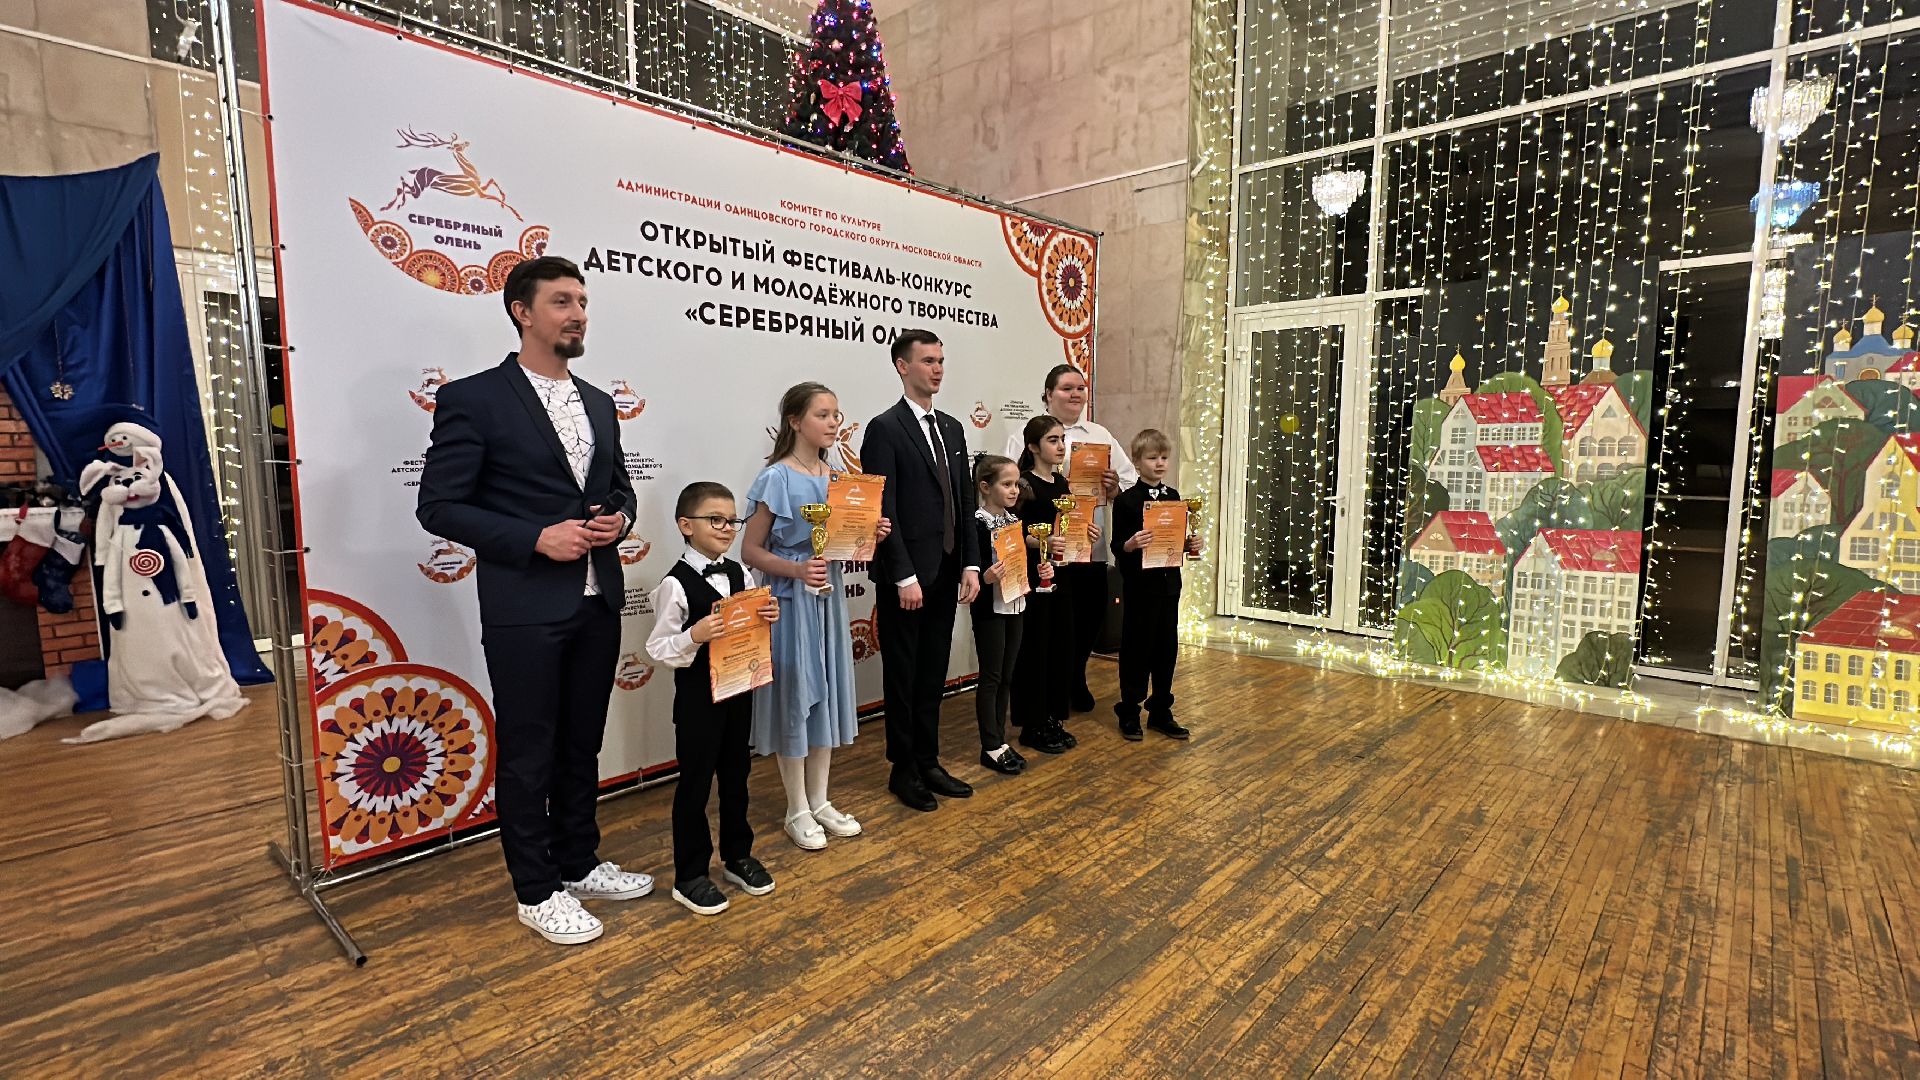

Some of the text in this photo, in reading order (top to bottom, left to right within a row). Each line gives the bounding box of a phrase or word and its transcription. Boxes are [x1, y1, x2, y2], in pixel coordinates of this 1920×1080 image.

[408, 213, 503, 238] СЕРЕБРЯНЫЙ
[616, 177, 983, 268] АДМИНИСТРАЦИИ ОДИНЦОВСКОГО ГОРОДСКОГО ОКРУГА МОСКОВСКОЙ ОБЛАСТИ
[780, 199, 881, 231] КОМИТЕТ ПО КУЛЬТУРЕ
[434, 234, 482, 250] ОЛЕНЬ
[640, 220, 972, 299] ОТКРЫТЫЙ ФЕСТИВАЛЬ-КОНКУРС
[584, 247, 999, 329] ДЕТСКОГО И МОЛОДЁЖНОГО ТВОРЧЕСТВА
[684, 301, 865, 343] «СЕРЕБРЯНЫЙ
